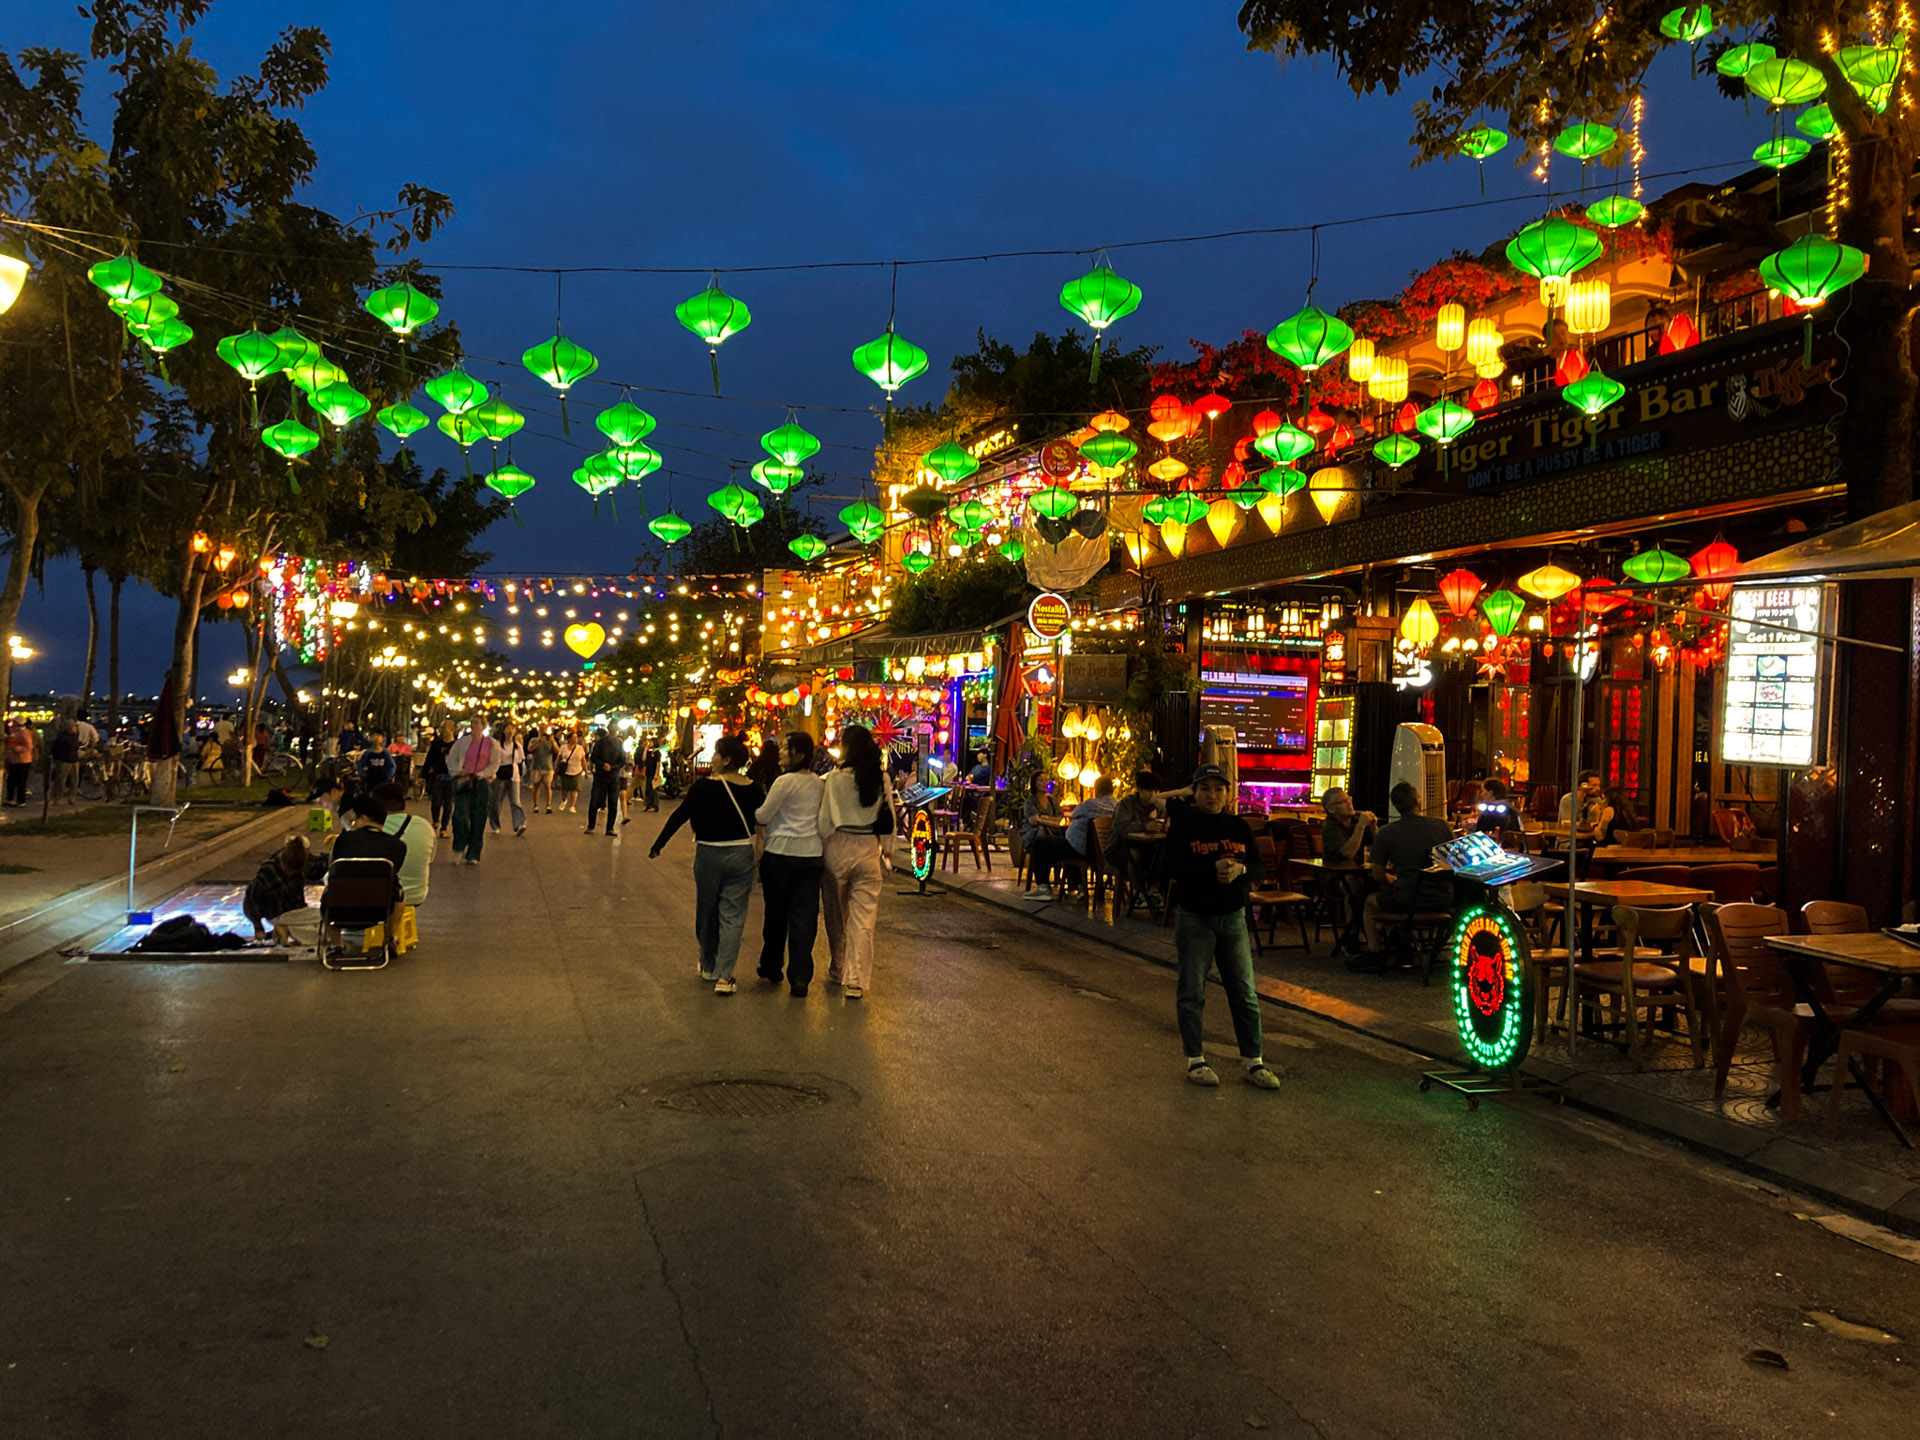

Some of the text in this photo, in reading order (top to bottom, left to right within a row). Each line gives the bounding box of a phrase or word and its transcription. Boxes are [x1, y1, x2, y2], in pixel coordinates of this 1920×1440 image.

[1753, 357, 1838, 406] Tiger
[1431, 377, 1720, 474] Tiger Tiger Bar
[1467, 430, 1662, 490] DON'T BE A PUSSY BE A TIGER
[1766, 590, 1790, 606] BEER
[1035, 603, 1066, 614] Nostalife
[1746, 632, 1767, 642] Get
[1768, 632, 1774, 642] 1
[1067, 662, 1086, 681] Tiger
[1087, 662, 1106, 681] Tiger
[1190, 840, 1219, 855] Tiger
[1460, 935, 1471, 966] TIGER
[1466, 918, 1485, 937] TIGER
[1485, 918, 1500, 937] BAR
